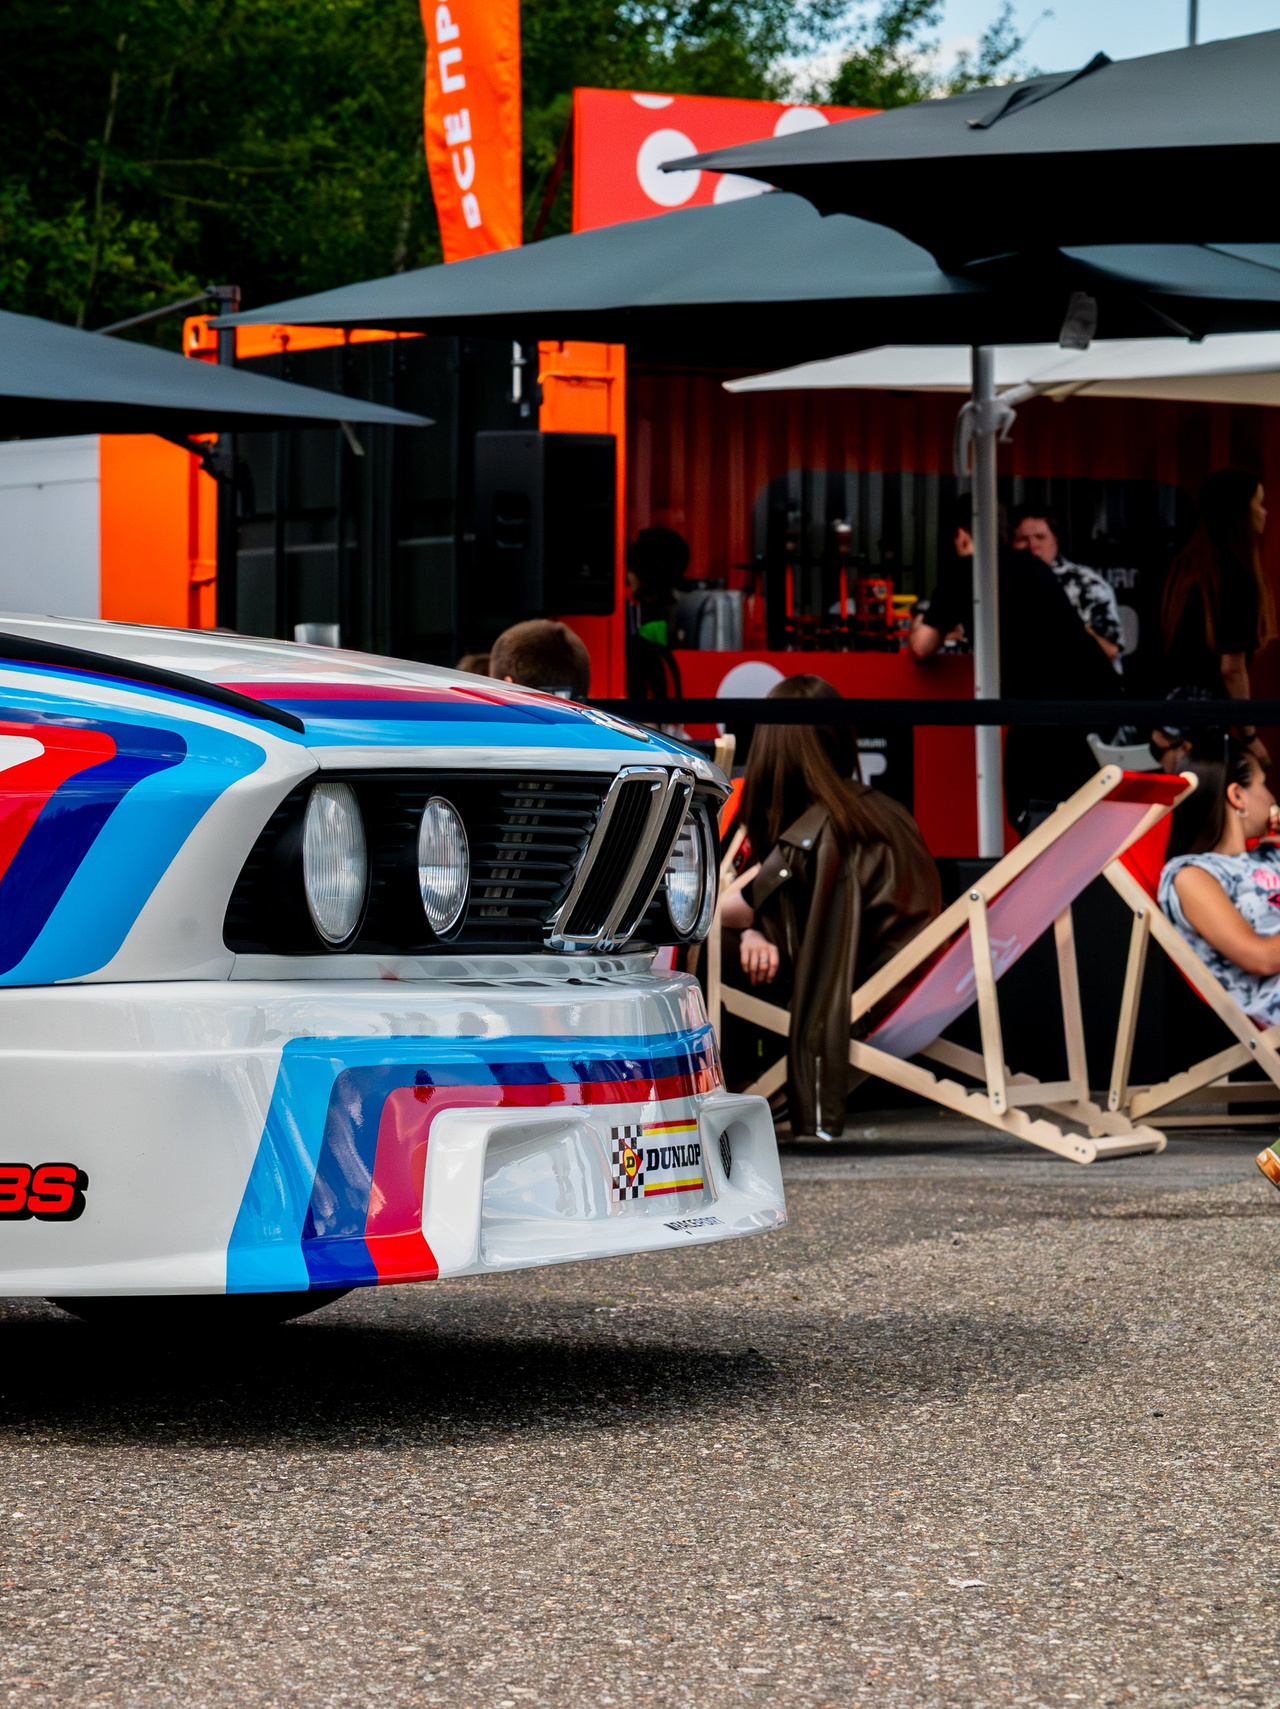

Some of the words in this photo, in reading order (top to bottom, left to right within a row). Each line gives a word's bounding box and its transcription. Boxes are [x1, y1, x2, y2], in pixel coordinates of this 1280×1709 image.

[435, 0, 466, 93] ПР
[625, 1156, 635, 1168] D
[646, 1143, 701, 1171] DUNLOP
